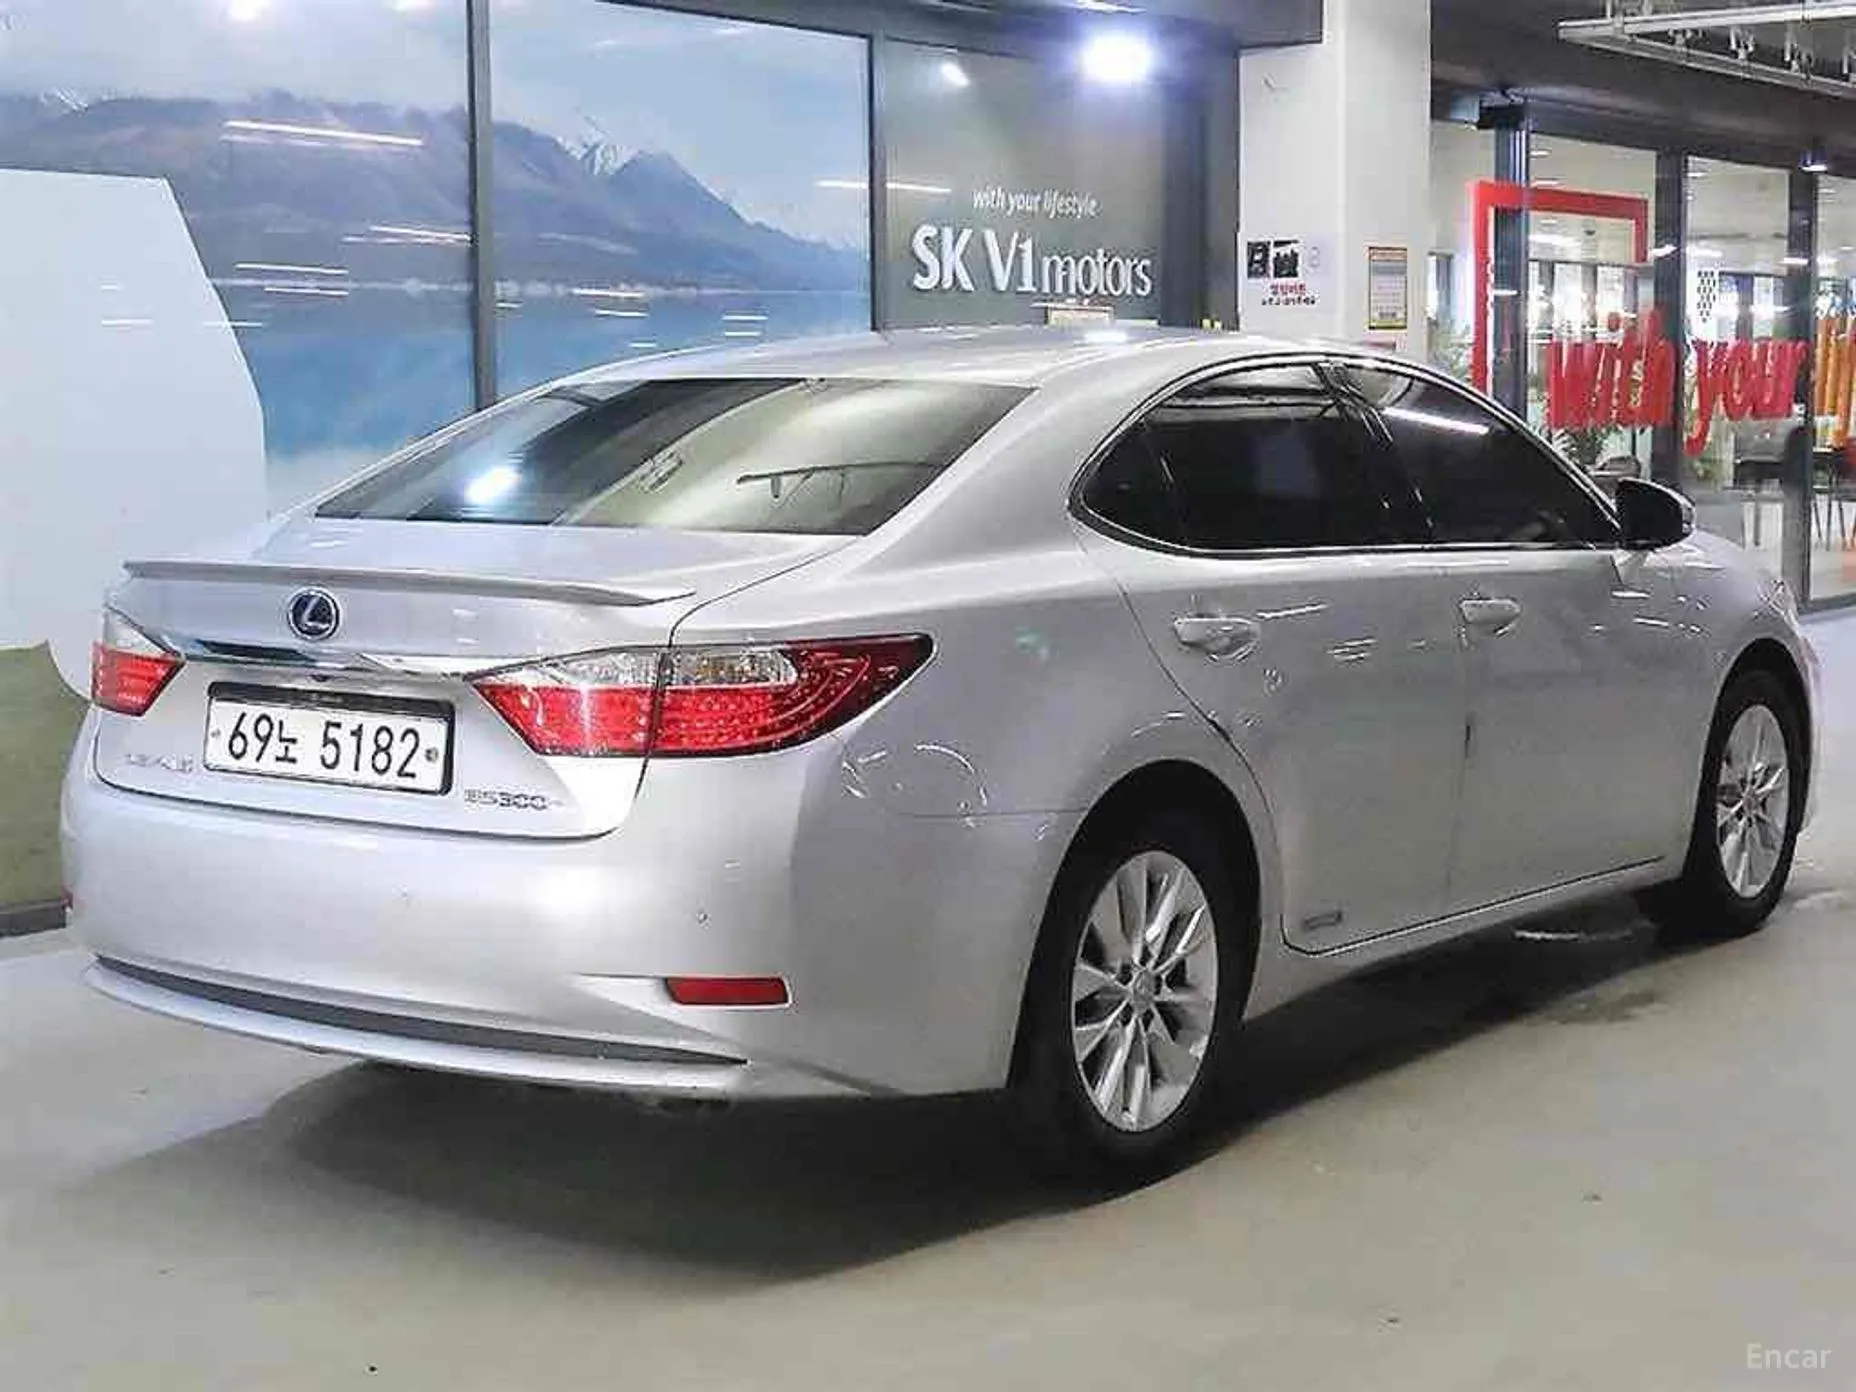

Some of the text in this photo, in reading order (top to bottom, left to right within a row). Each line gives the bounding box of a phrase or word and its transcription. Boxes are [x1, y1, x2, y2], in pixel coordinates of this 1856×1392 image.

[973, 186, 1006, 209] with
[1007, 190, 1041, 217] your
[911, 223, 975, 292] SK
[1683, 337, 1807, 456] your
[228, 711, 419, 778] 69노 5182
